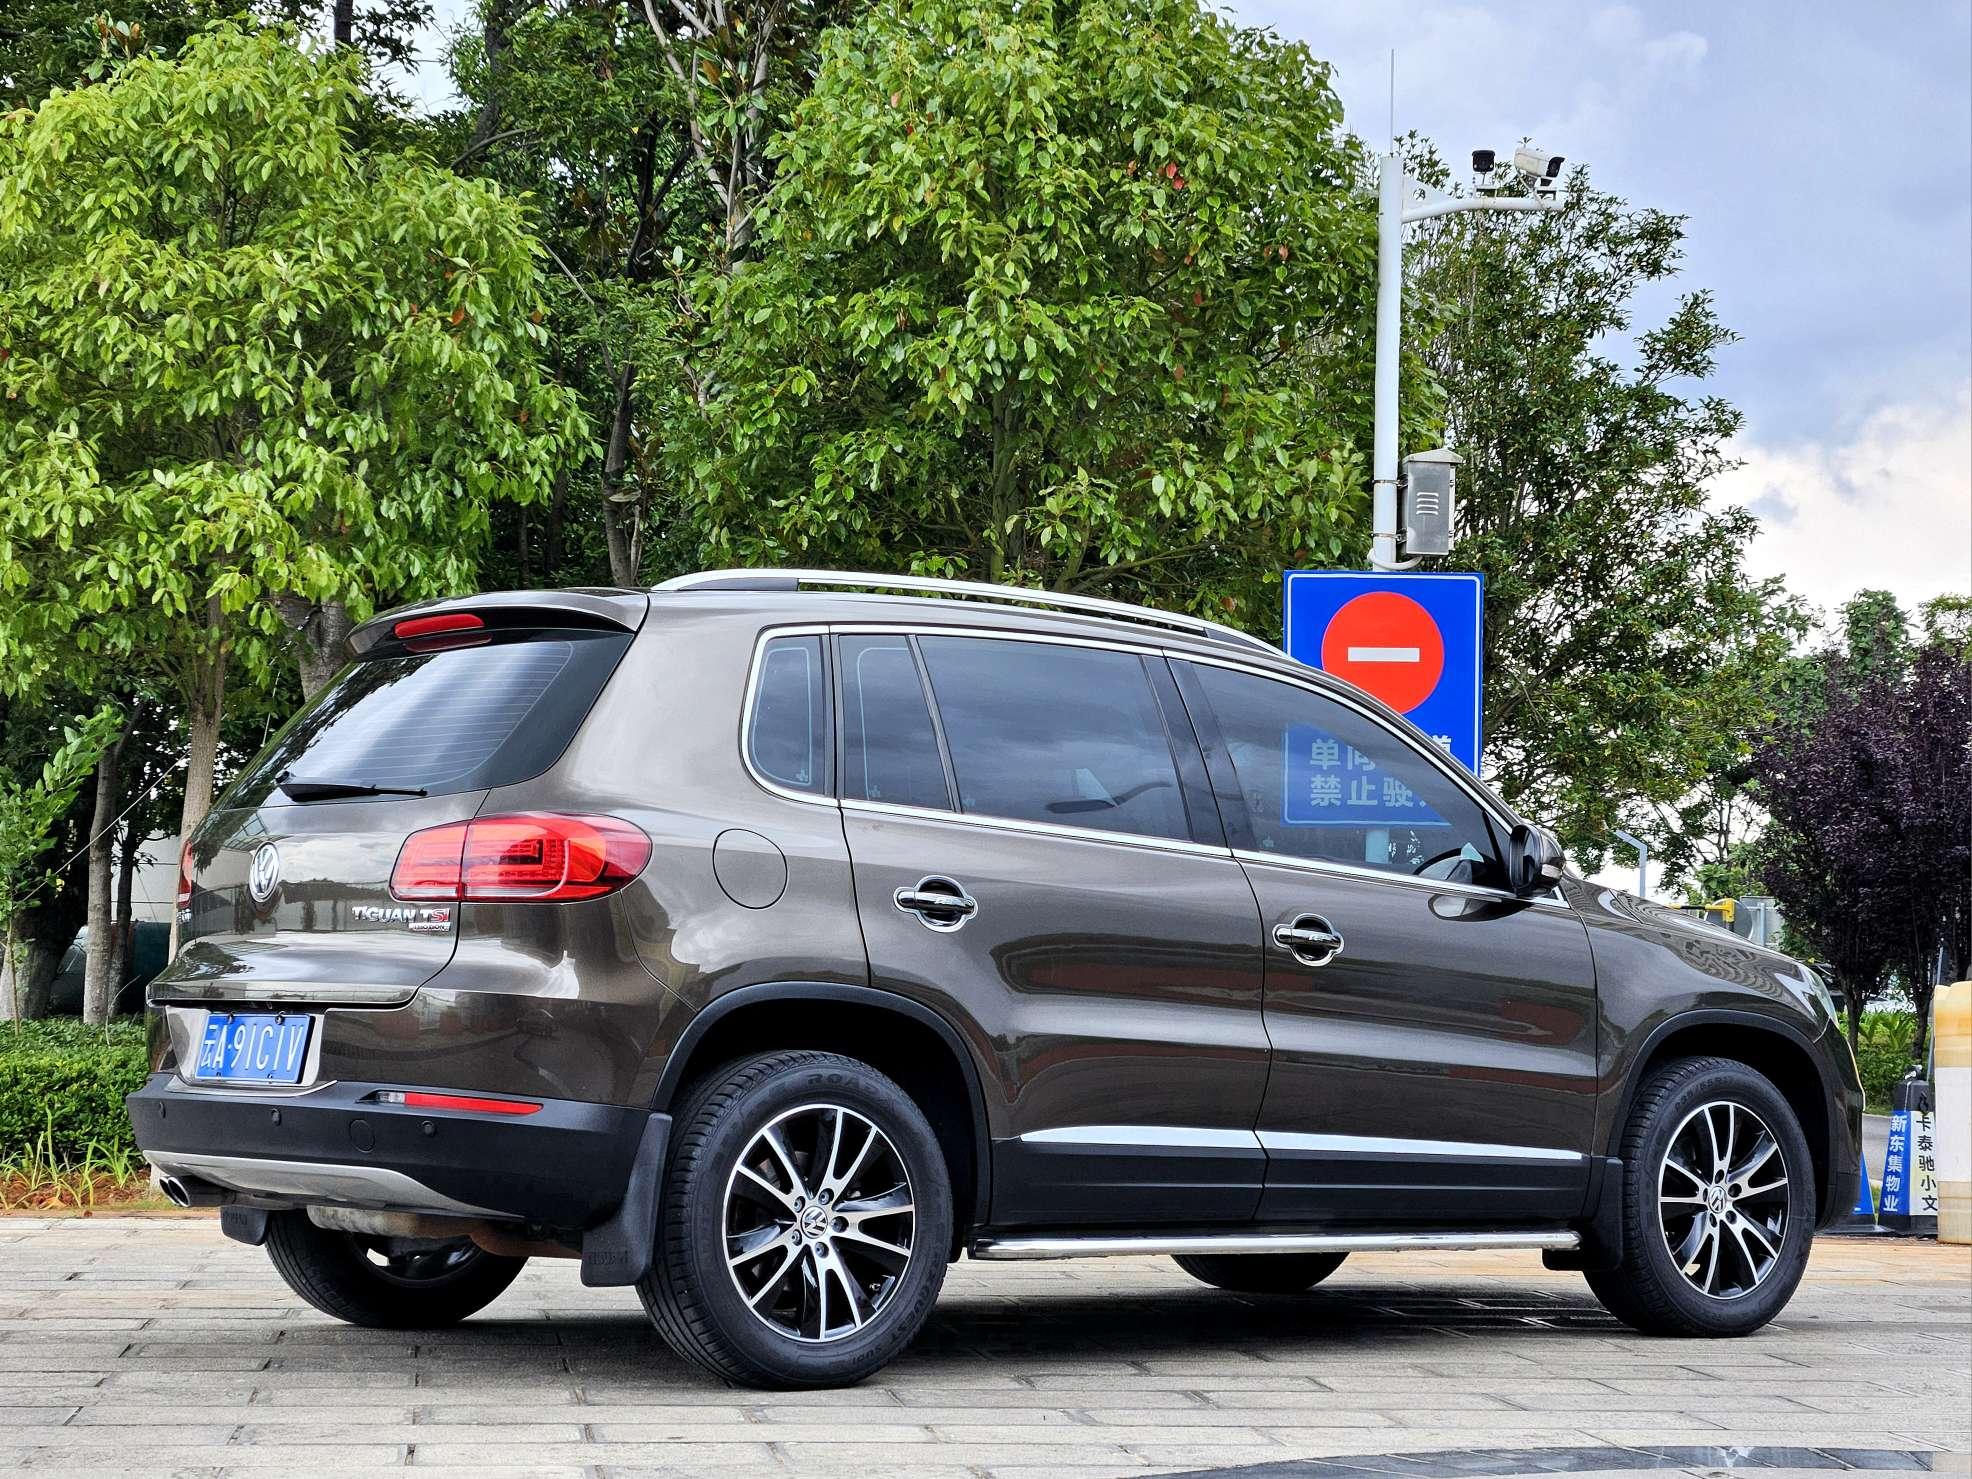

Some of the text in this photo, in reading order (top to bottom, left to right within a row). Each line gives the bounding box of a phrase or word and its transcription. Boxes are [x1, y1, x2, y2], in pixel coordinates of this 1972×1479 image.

[1310, 774, 1427, 808] 禁止驶
[352, 905, 450, 922] TIGUAN TSI
